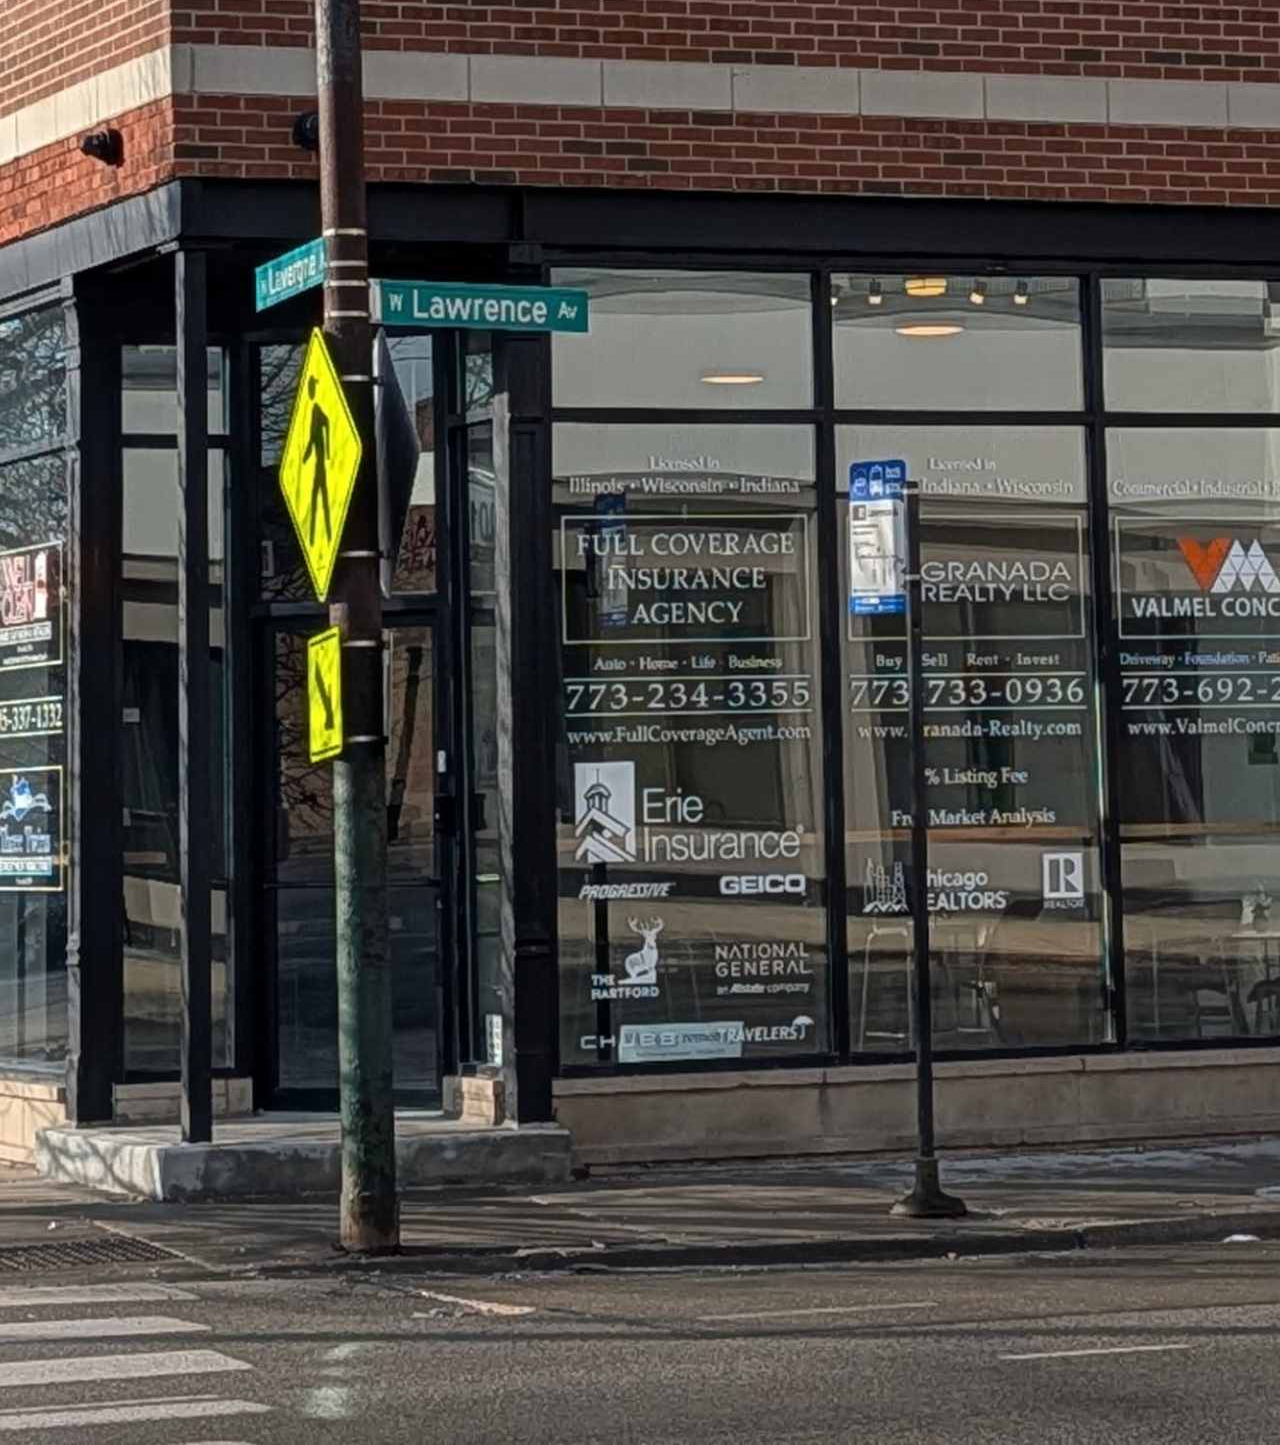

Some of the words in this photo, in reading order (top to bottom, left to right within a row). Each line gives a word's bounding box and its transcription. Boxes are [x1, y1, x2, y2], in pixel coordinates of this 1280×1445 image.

[389, 294, 402, 311] W
[413, 289, 547, 323] Lawrence
[558, 301, 577, 319] Av
[570, 477, 624, 494] Illinois
[641, 477, 723, 494] Wisconsin
[740, 477, 800, 494] Indiana
[921, 477, 981, 495] Indiana
[995, 477, 1073, 495] Wisconsin
[1113, 479, 1190, 496] Commercial
[1200, 479, 1261, 497] Industrial
[577, 533, 645, 556] FULL
[651, 532, 794, 556] COVERAGE
[608, 566, 767, 590] INSURANCE
[920, 561, 1071, 582] GRANADA
[921, 584, 1016, 602] REALTY
[1023, 583, 1070, 602] LLC
[631, 601, 744, 625] AGENCY
[1132, 597, 1216, 617] VALMEL
[594, 657, 626, 671] Auto
[639, 656, 678, 670] Home
[691, 656, 716, 669] Life
[728, 655, 783, 669] Business
[876, 654, 903, 670] Buy
[921, 653, 948, 667] Sell
[967, 653, 999, 666] Rent
[1016, 652, 1060, 665] Invest
[1120, 653, 1175, 668] Driveway
[1184, 652, 1250, 665] Foundation
[566, 680, 810, 710] 773-234-3355
[567, 723, 811, 745] www.FullCoverageAgent.com
[944, 767, 997, 788] Listing
[1002, 767, 1028, 785] Fee
[643, 787, 704, 823] Erie
[930, 809, 985, 826] Market
[990, 807, 1056, 828] Analysis
[643, 826, 801, 862] Insurance
[579, 882, 673, 900] PROGRESSIVE
[720, 874, 806, 894] GEICO
[927, 868, 988, 891] hicago
[927, 891, 1007, 911] EALTORS
[715, 942, 810, 961] NATIONAL
[715, 960, 812, 978] GENERAL
[592, 975, 616, 986] THE
[592, 986, 660, 1001] HARTFORD
[580, 1031, 679, 1050] CHUBB
[718, 1025, 799, 1043] TRAVELERS
